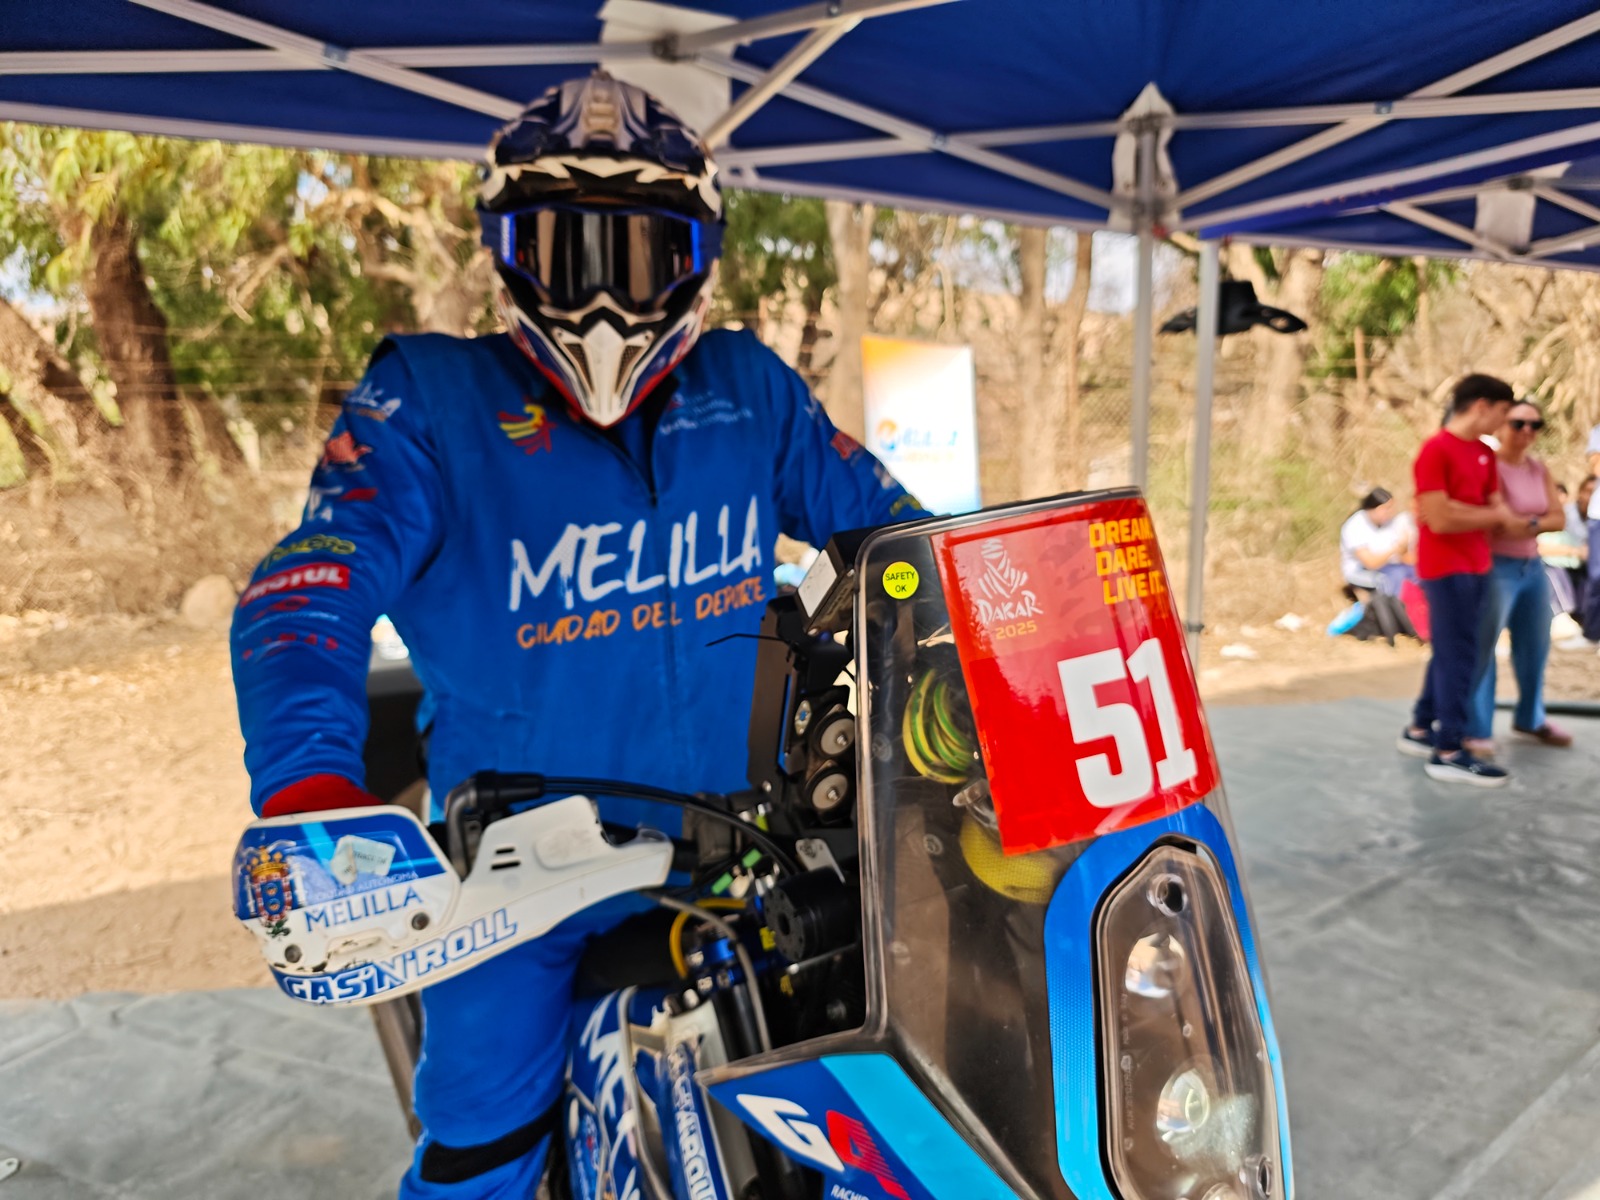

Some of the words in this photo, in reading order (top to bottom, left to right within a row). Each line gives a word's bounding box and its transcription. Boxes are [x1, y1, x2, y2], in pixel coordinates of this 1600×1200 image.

[509, 494, 762, 612] MELILLA
[1096, 545, 1152, 576] DARE.
[885, 571, 915, 582] SAFETY
[895, 584, 907, 593] OK
[1103, 573, 1149, 605] LIVE
[632, 602, 682, 631] DEL
[976, 589, 1044, 626] DAKAR
[995, 620, 1038, 640] 2025
[1057, 637, 1198, 808] 51
[303, 886, 424, 932] MELILLA
